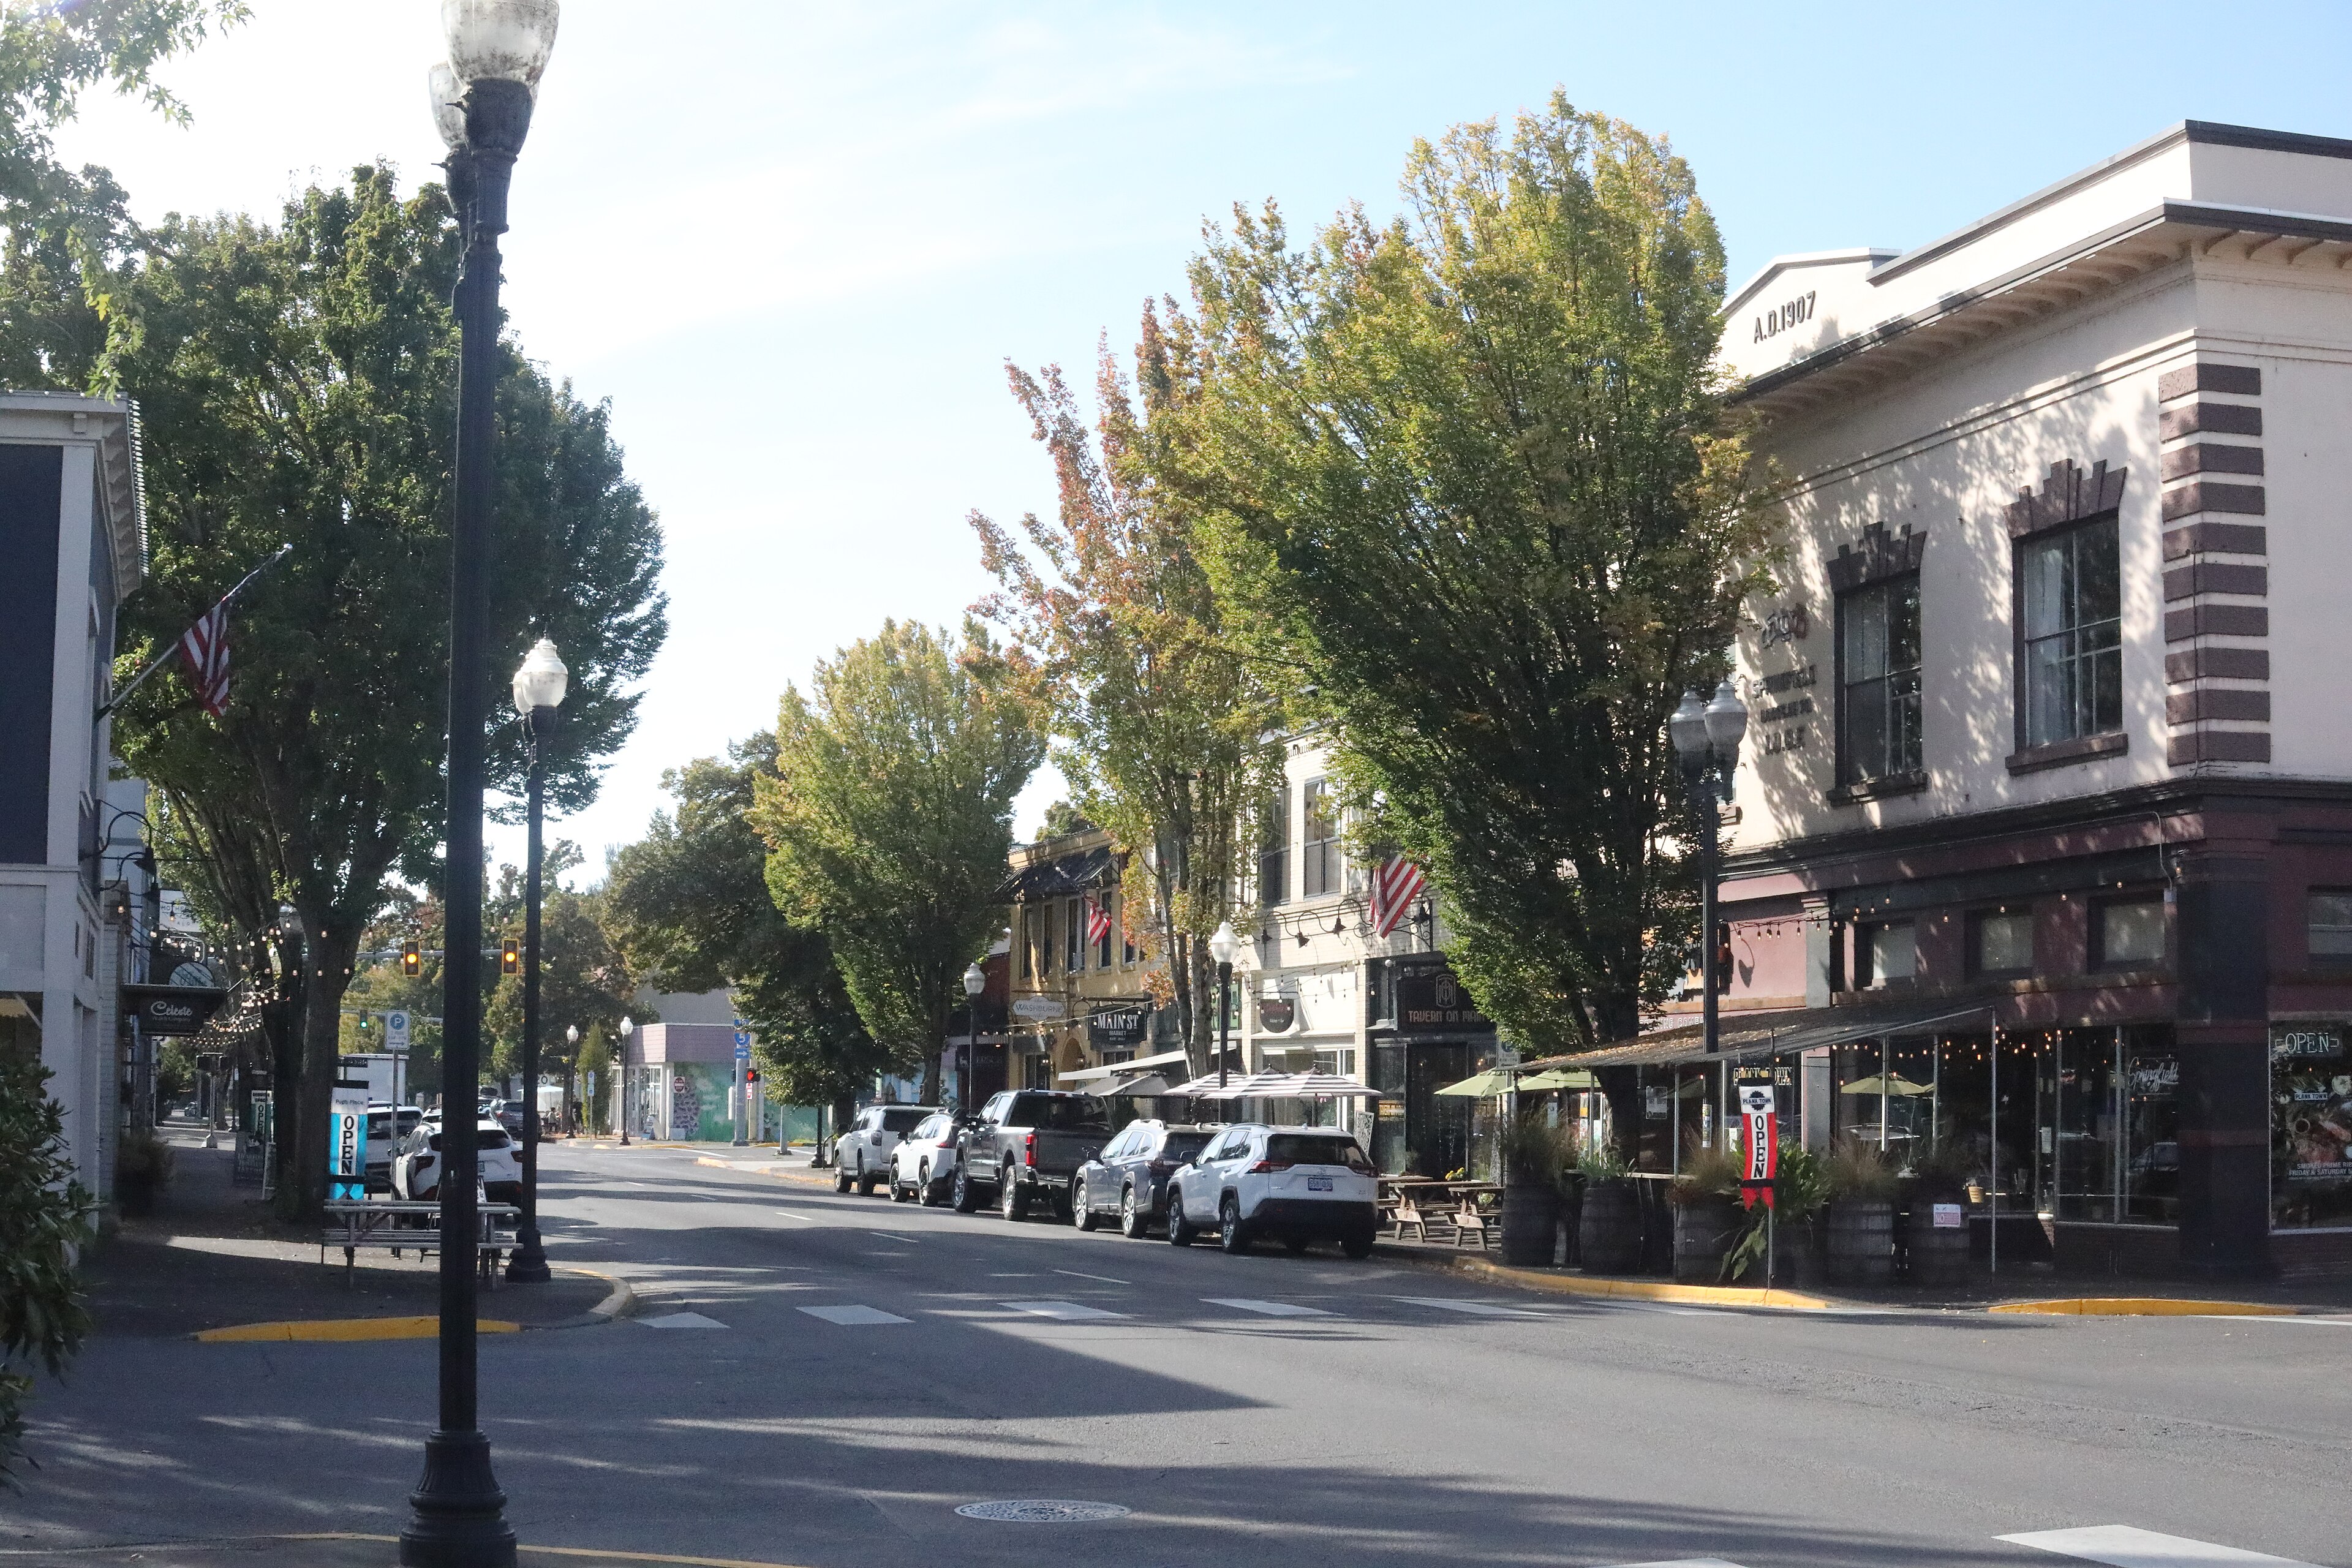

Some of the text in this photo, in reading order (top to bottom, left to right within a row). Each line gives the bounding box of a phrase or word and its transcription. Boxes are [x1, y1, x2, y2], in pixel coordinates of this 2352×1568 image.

[1098, 1014, 1139, 1029] MAIN ST
[1409, 1011, 1442, 1022] TAVERN
[1447, 1011, 1458, 1022] ON
[739, 1034, 745, 1043] 5
[2286, 1033, 2329, 1054] OPEN
[2128, 1057, 2179, 1092] Springfield
[341, 1115, 355, 1174] OPEN
[1754, 1115, 1765, 1178] OPEN
[1936, 1213, 1945, 1224] NO
